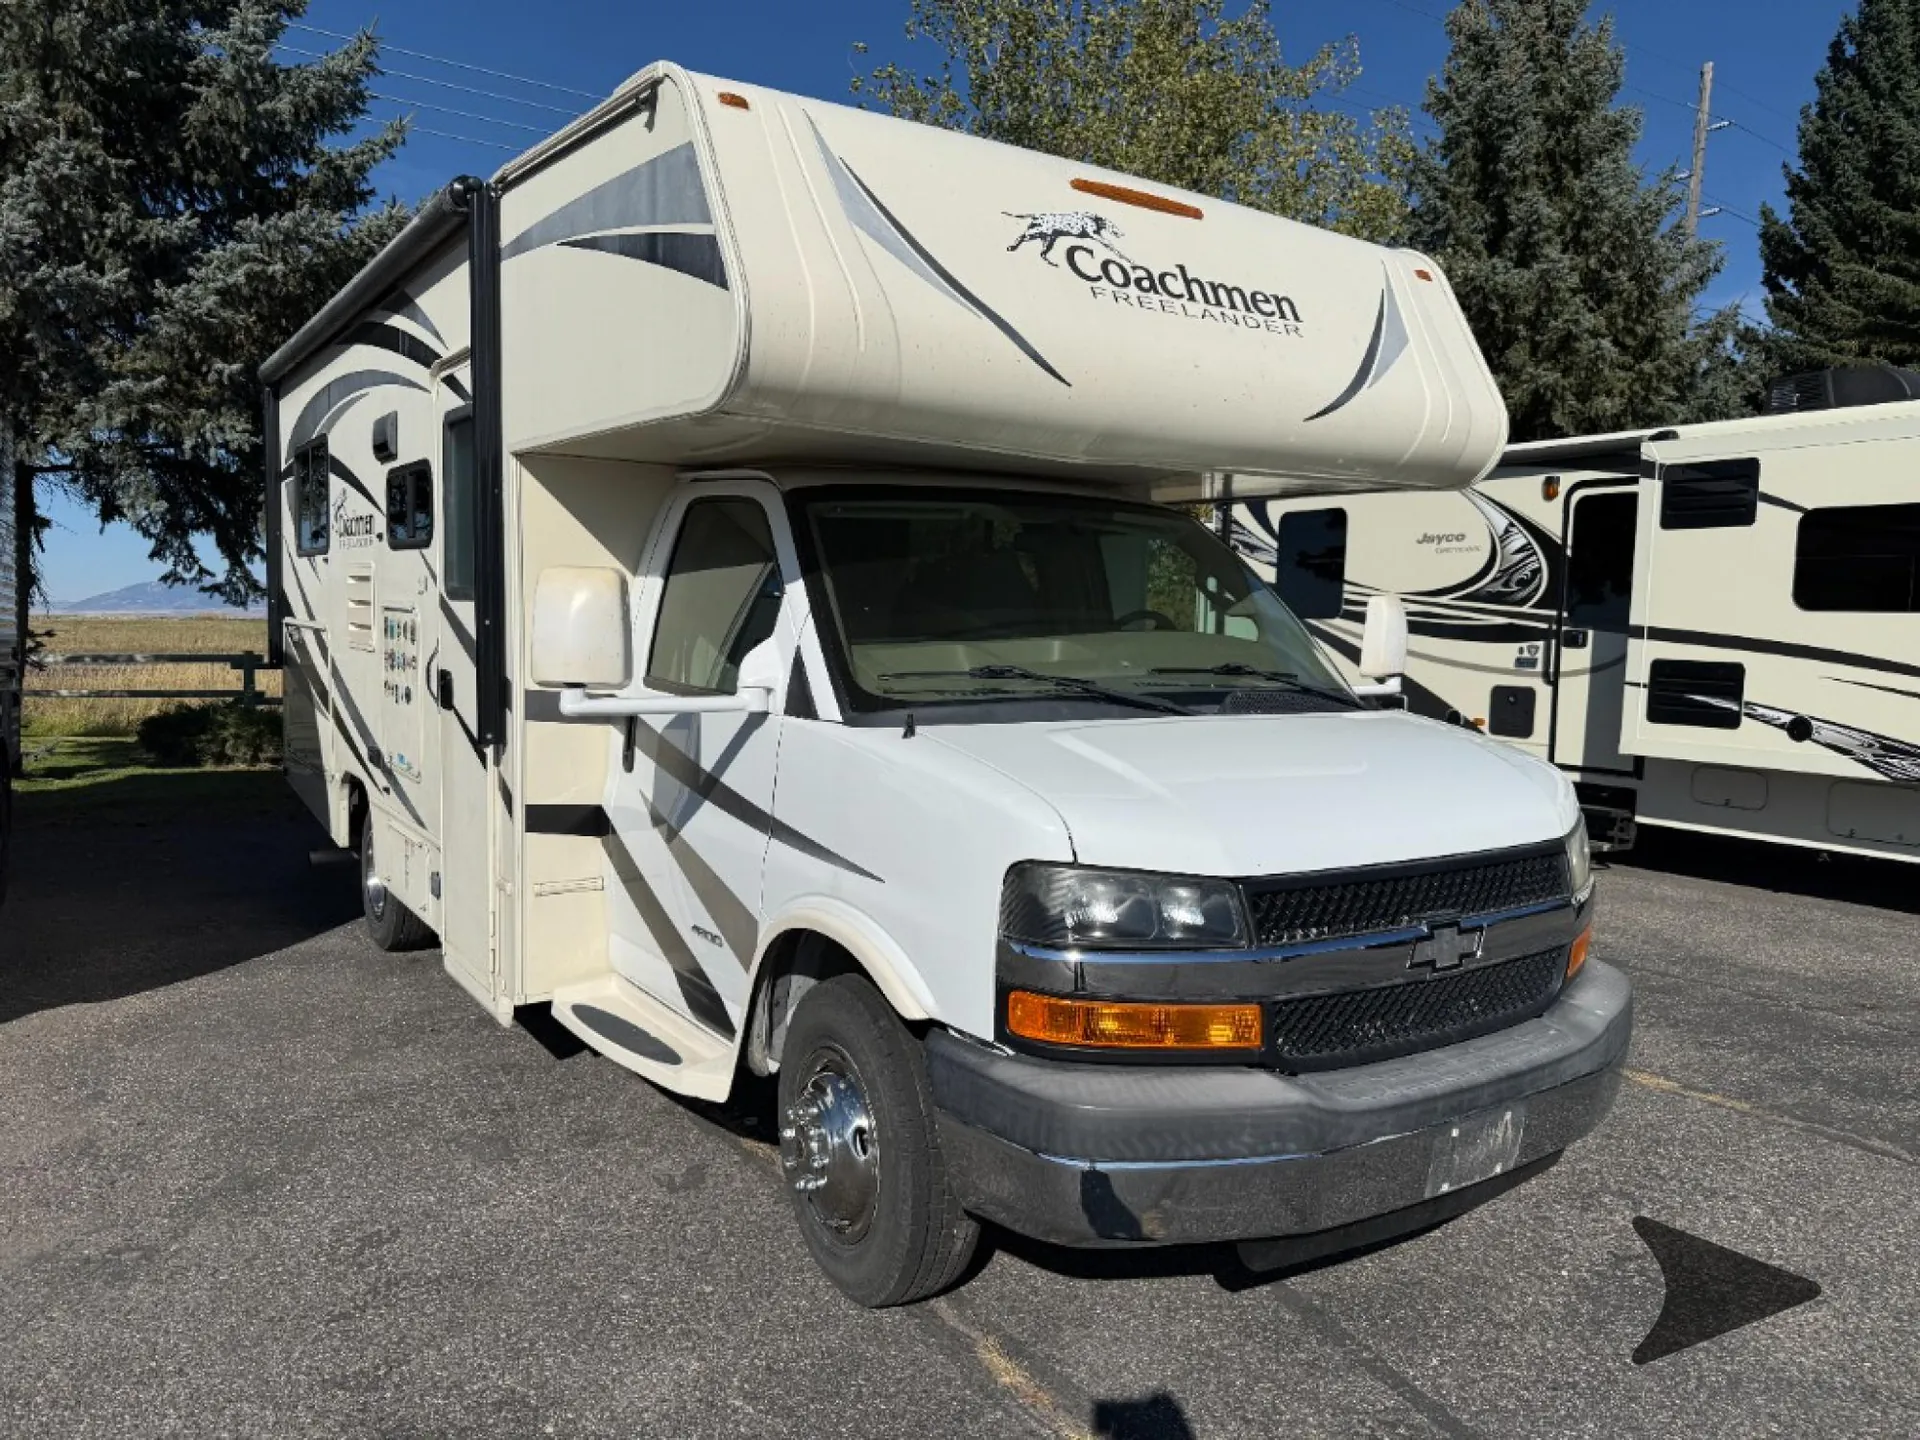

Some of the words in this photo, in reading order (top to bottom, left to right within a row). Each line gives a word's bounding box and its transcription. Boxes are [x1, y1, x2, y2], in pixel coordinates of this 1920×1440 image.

[1066, 245, 1303, 323] Coachmen
[1091, 287, 1303, 338] FREELANDER
[1416, 532, 1466, 546] Jayco
